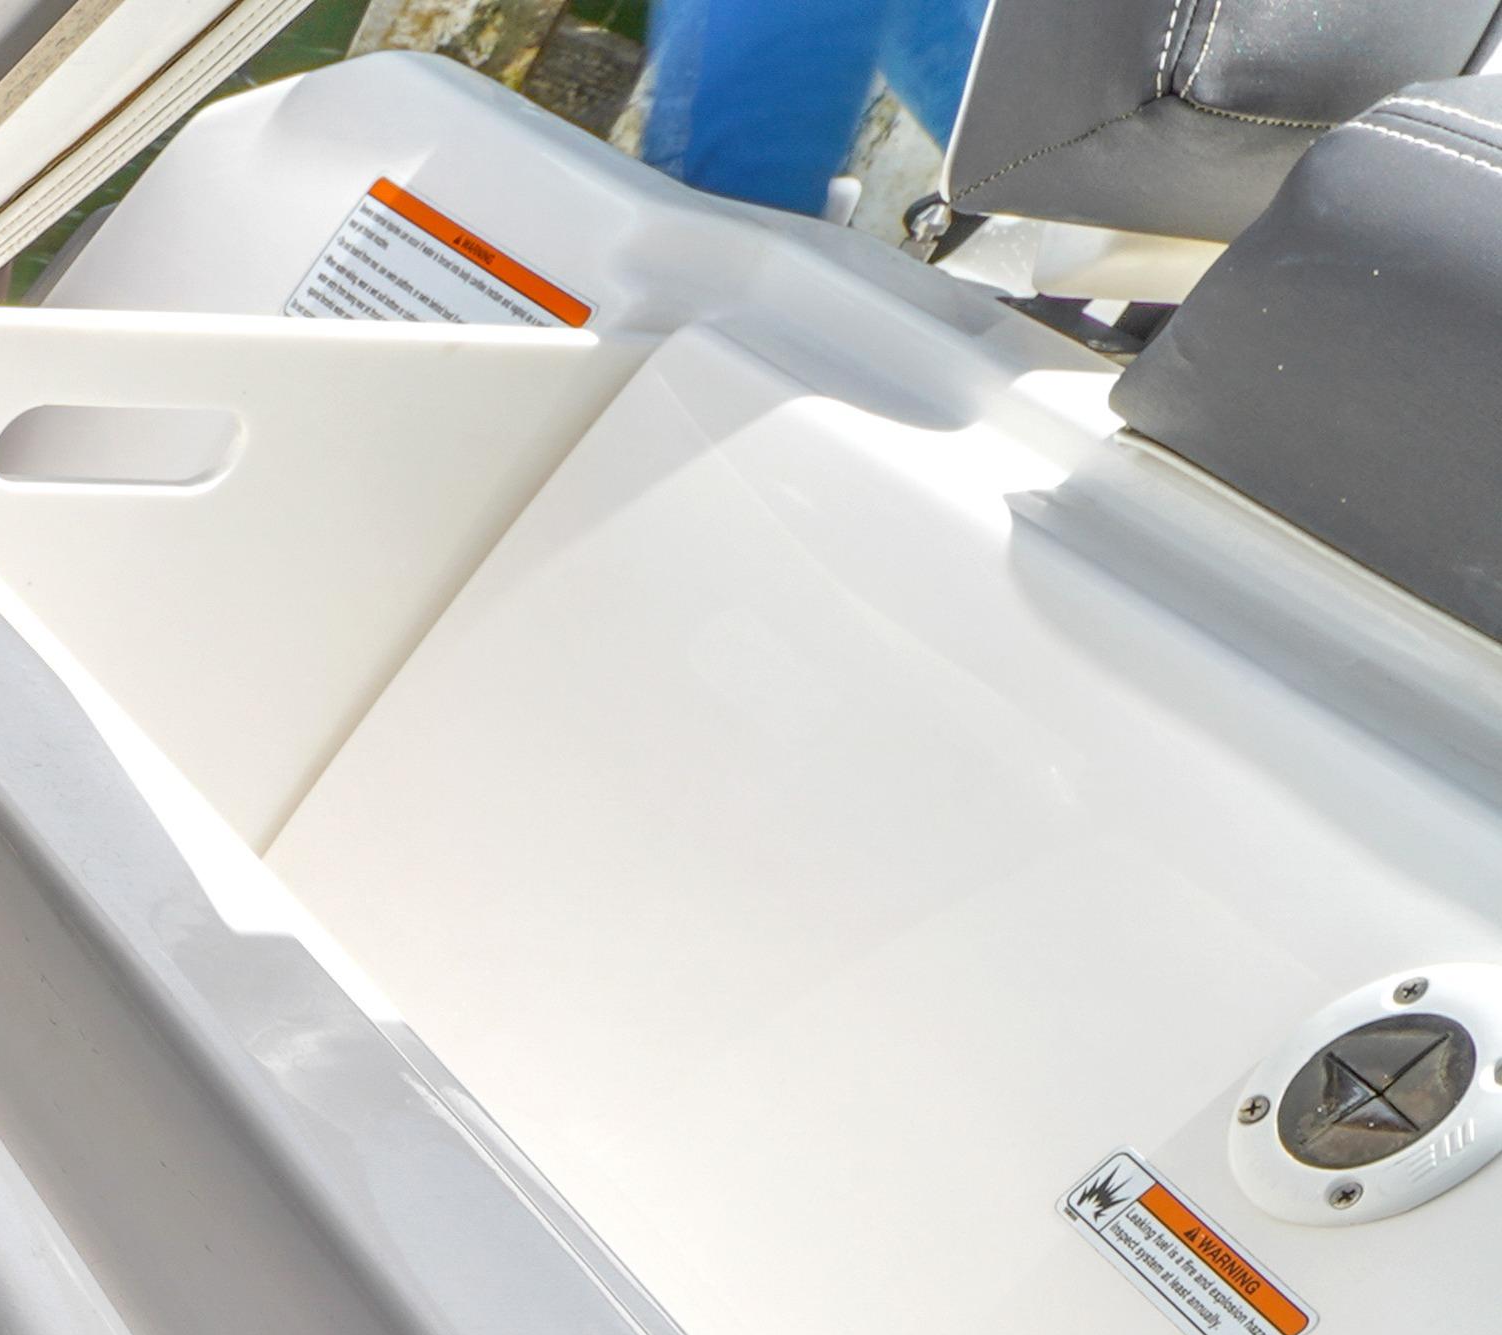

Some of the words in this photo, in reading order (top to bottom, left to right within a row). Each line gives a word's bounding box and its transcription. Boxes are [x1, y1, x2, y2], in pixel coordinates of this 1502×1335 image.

[1110, 1221, 1140, 1251] Inspect
[1135, 1247, 1164, 1275] system
[1169, 1277, 1191, 1299] least
[1186, 1296, 1221, 1330] annually.
[1125, 1208, 1156, 1240] Leaking
[1153, 1234, 1173, 1252] fuel
[1181, 1260, 1197, 1276] fire
[1194, 1274, 1215, 1290] and
[1209, 1288, 1247, 1323] explosion
[1197, 1236, 1260, 1295] WARNING
